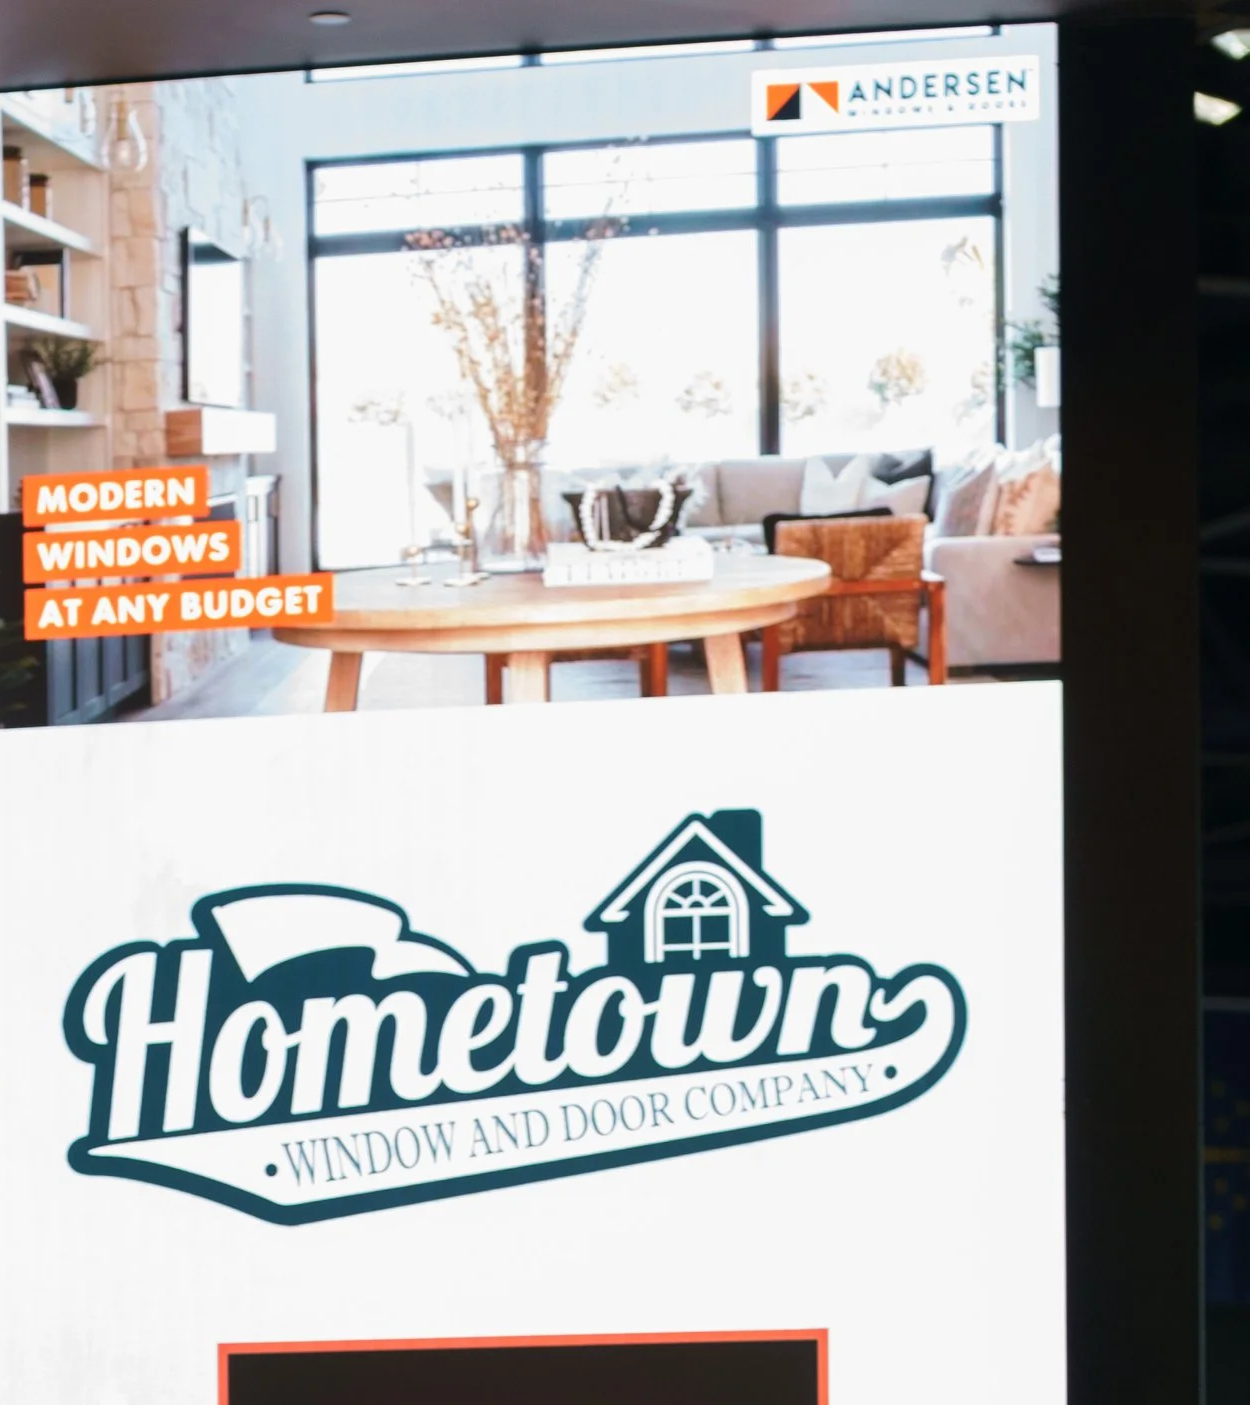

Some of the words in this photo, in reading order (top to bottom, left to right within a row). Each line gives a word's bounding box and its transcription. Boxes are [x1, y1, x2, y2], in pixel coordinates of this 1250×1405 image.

[847, 69, 1028, 103] ANDERSEN
[36, 476, 196, 515] MODERN
[37, 531, 230, 571] WINDOWS
[38, 598, 83, 629] AT
[91, 592, 171, 625] ANY
[180, 585, 324, 621] BUDGET
[83, 950, 880, 1140] Hometown
[281, 1119, 457, 1188] WINDOW
[467, 1103, 551, 1160] AND
[561, 1089, 676, 1144] DOOR
[684, 1062, 875, 1122] COMPANY
